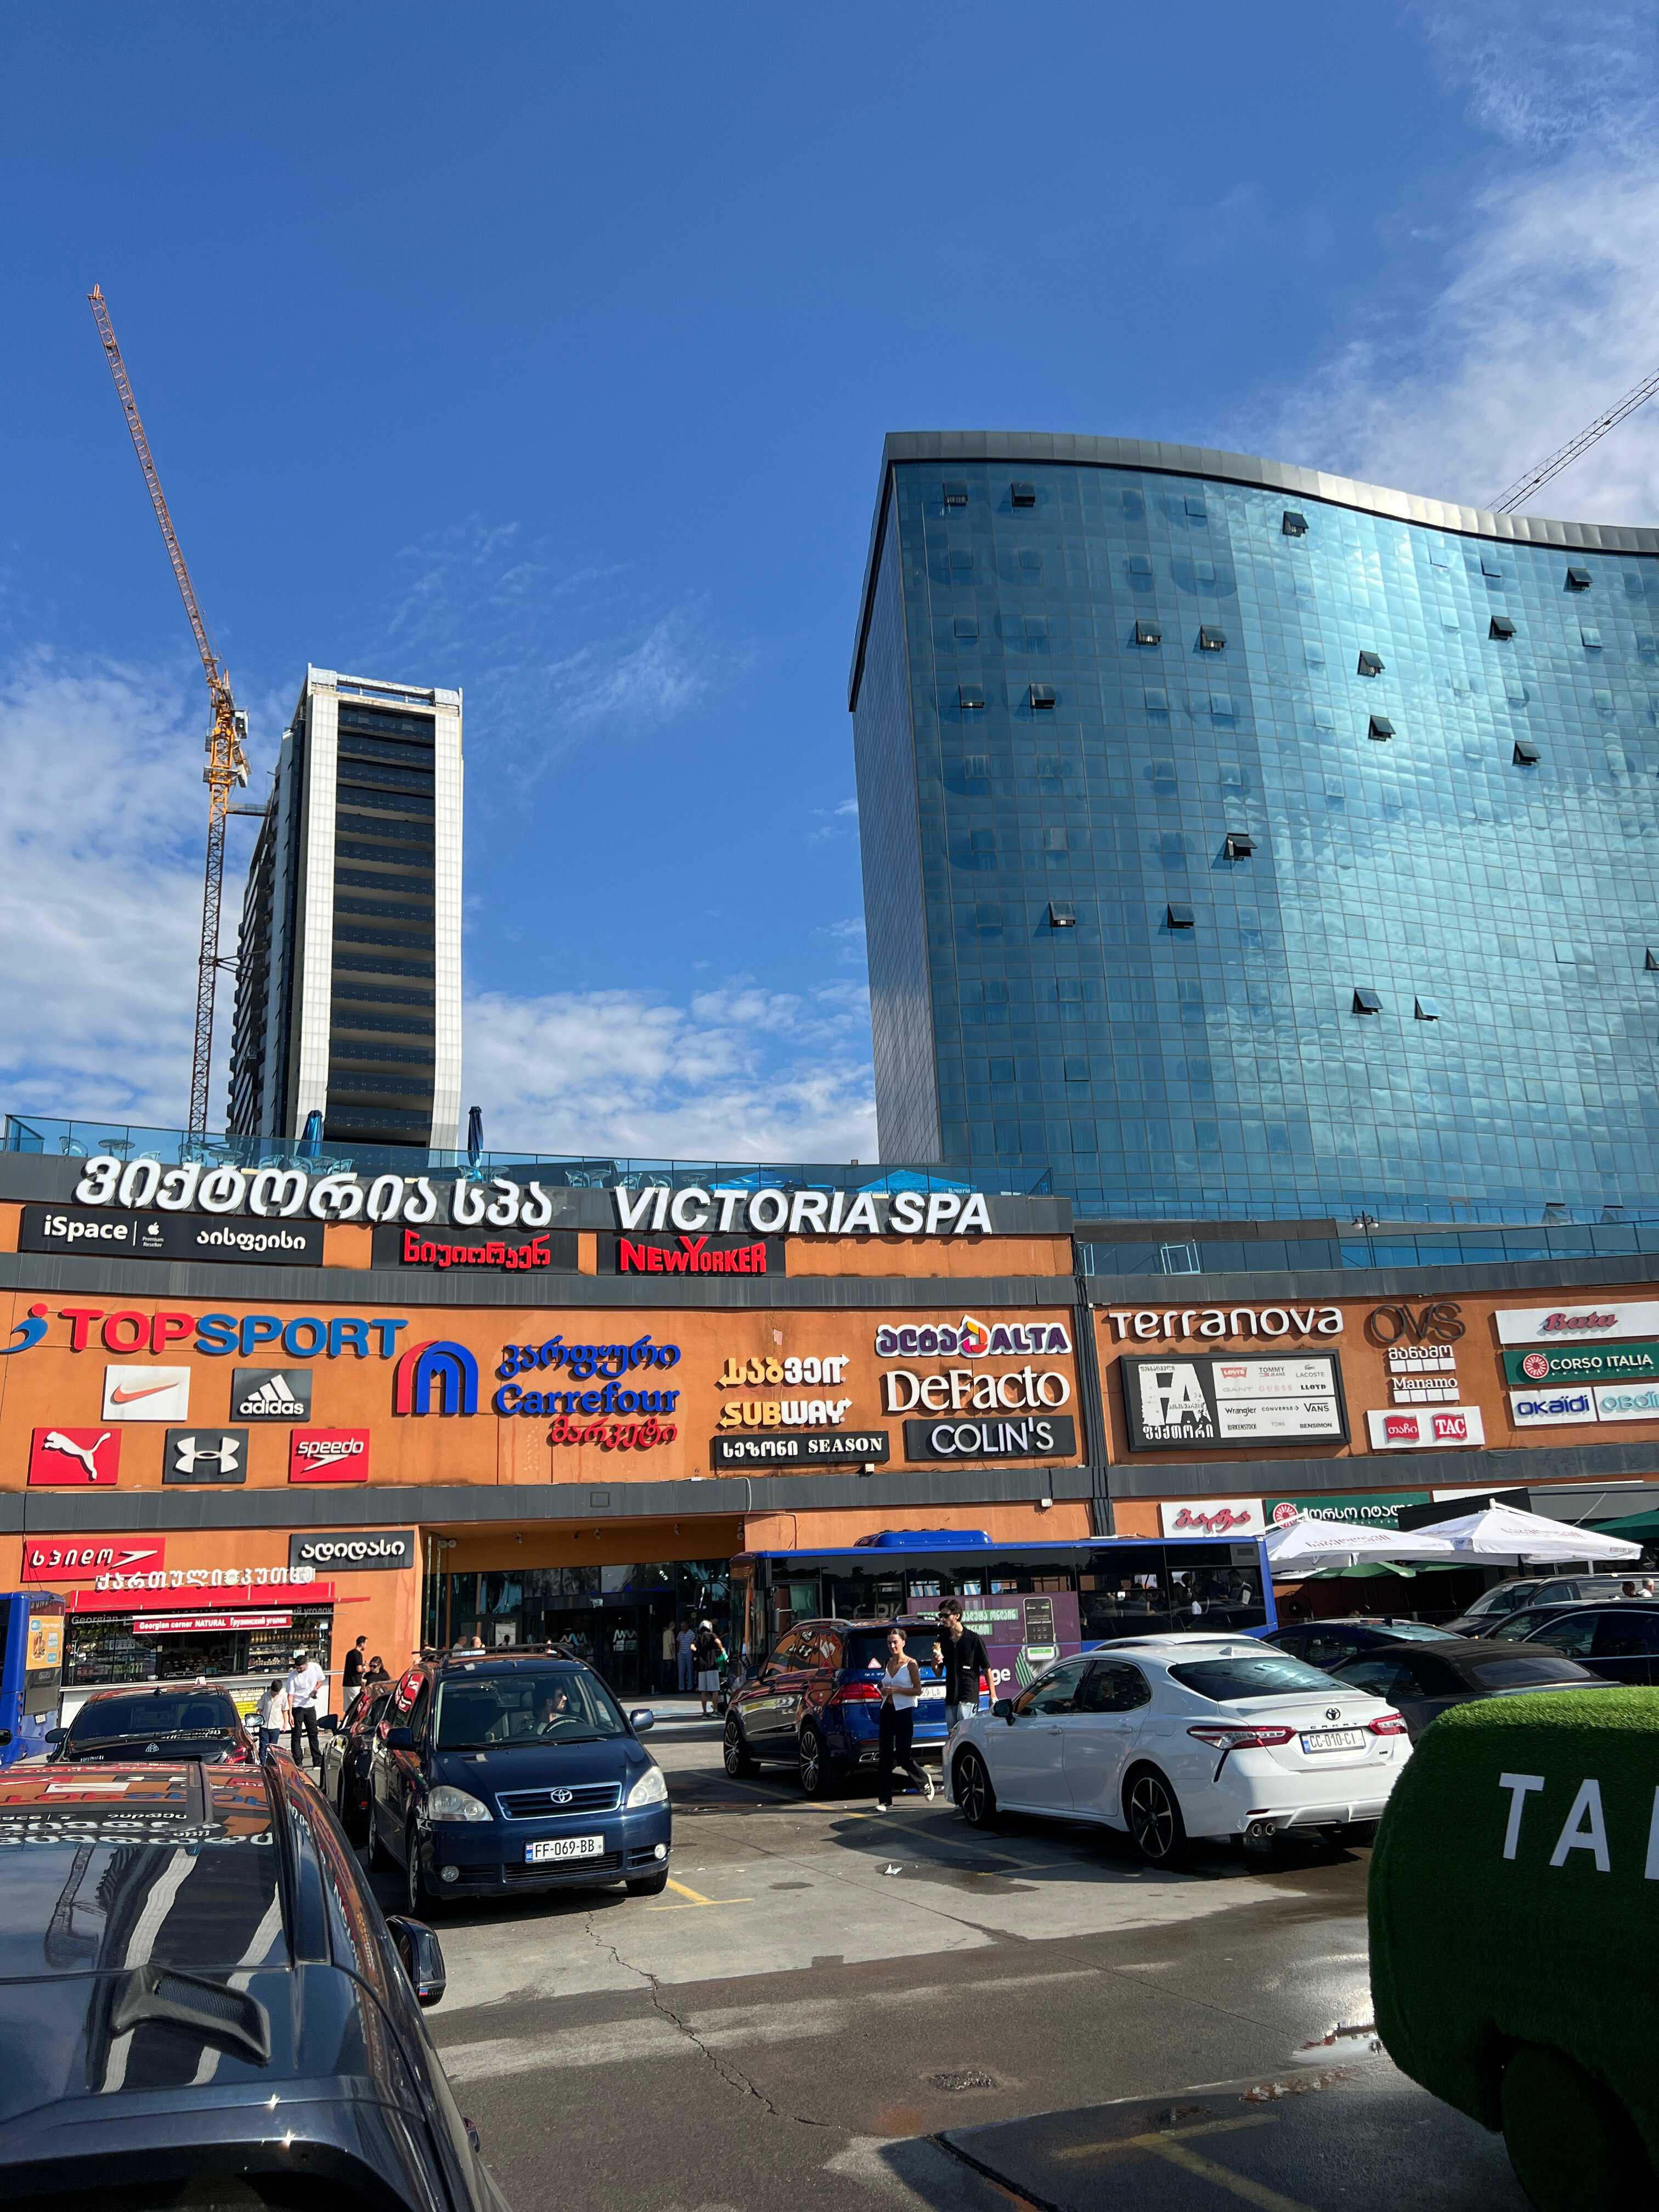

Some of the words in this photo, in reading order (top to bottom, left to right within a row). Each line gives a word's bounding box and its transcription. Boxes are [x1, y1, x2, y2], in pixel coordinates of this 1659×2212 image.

[76, 1155, 438, 1223] ვიქტორია
[452, 1178, 552, 1228] სპა
[614, 1186, 878, 1234] VICTORIA
[888, 1192, 992, 1234] SPA
[45, 1215, 128, 1242] iSpace
[196, 1227, 306, 1251] აისფეისი
[404, 1229, 550, 1269] ნიუიორკერ
[1372, 1302, 1466, 1343] OVS
[1543, 1312, 1618, 1331] Bata
[57, 1308, 409, 1358] TOPSPORT
[990, 1325, 1070, 1352] ALTA
[500, 1334, 681, 1377] კარფური
[1388, 1345, 1454, 1360] მანამო
[1550, 1357, 1602, 1370] CORSO
[1606, 1354, 1654, 1367] ITALIA
[886, 1365, 1070, 1411] DeFacto
[1391, 1377, 1458, 1390] Manamo
[239, 1399, 304, 1415] adidas
[496, 1381, 680, 1414] Carrefour
[1304, 1402, 1330, 1412] VANS
[719, 1398, 853, 1428] SUBWAY
[1225, 1407, 1257, 1417] Wrangler
[551, 1415, 678, 1448] მარკეტი
[932, 1417, 1054, 1454] COLIN'S
[1387, 1423, 1418, 1435] თაჩი
[297, 1437, 364, 1456] speedo
[723, 1440, 799, 1458] სეზონი
[808, 1437, 883, 1454] SEASON
[1304, 1507, 1357, 1520] ორსო
[32, 1548, 114, 1566] სპიდო
[301, 1539, 405, 1561] ადიდასი
[139, 1621, 169, 1630] Georgian
[195, 1619, 227, 1628] NATURAL
[230, 1616, 266, 1628] Грузинский
[266, 1616, 287, 1626] уголок
[1498, 1772, 1659, 1880] TA
[535, 1839, 595, 1858] FF-069-BB
